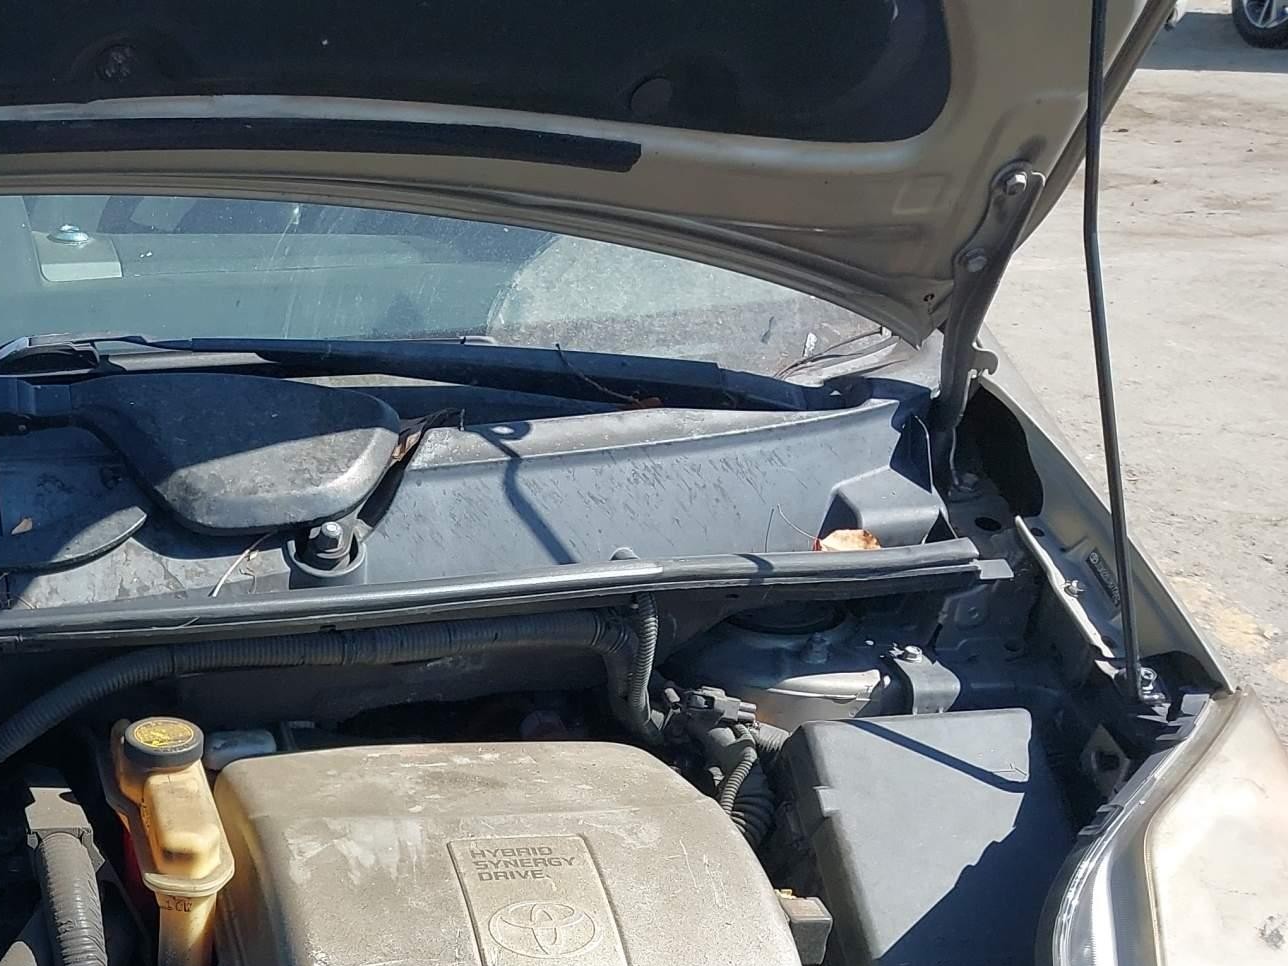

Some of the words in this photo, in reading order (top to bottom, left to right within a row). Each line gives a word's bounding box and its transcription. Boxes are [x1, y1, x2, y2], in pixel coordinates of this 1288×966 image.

[470, 847, 553, 858] HYBRID
[472, 857, 576, 869] SYNERGY
[478, 870, 545, 881] DRIVE
